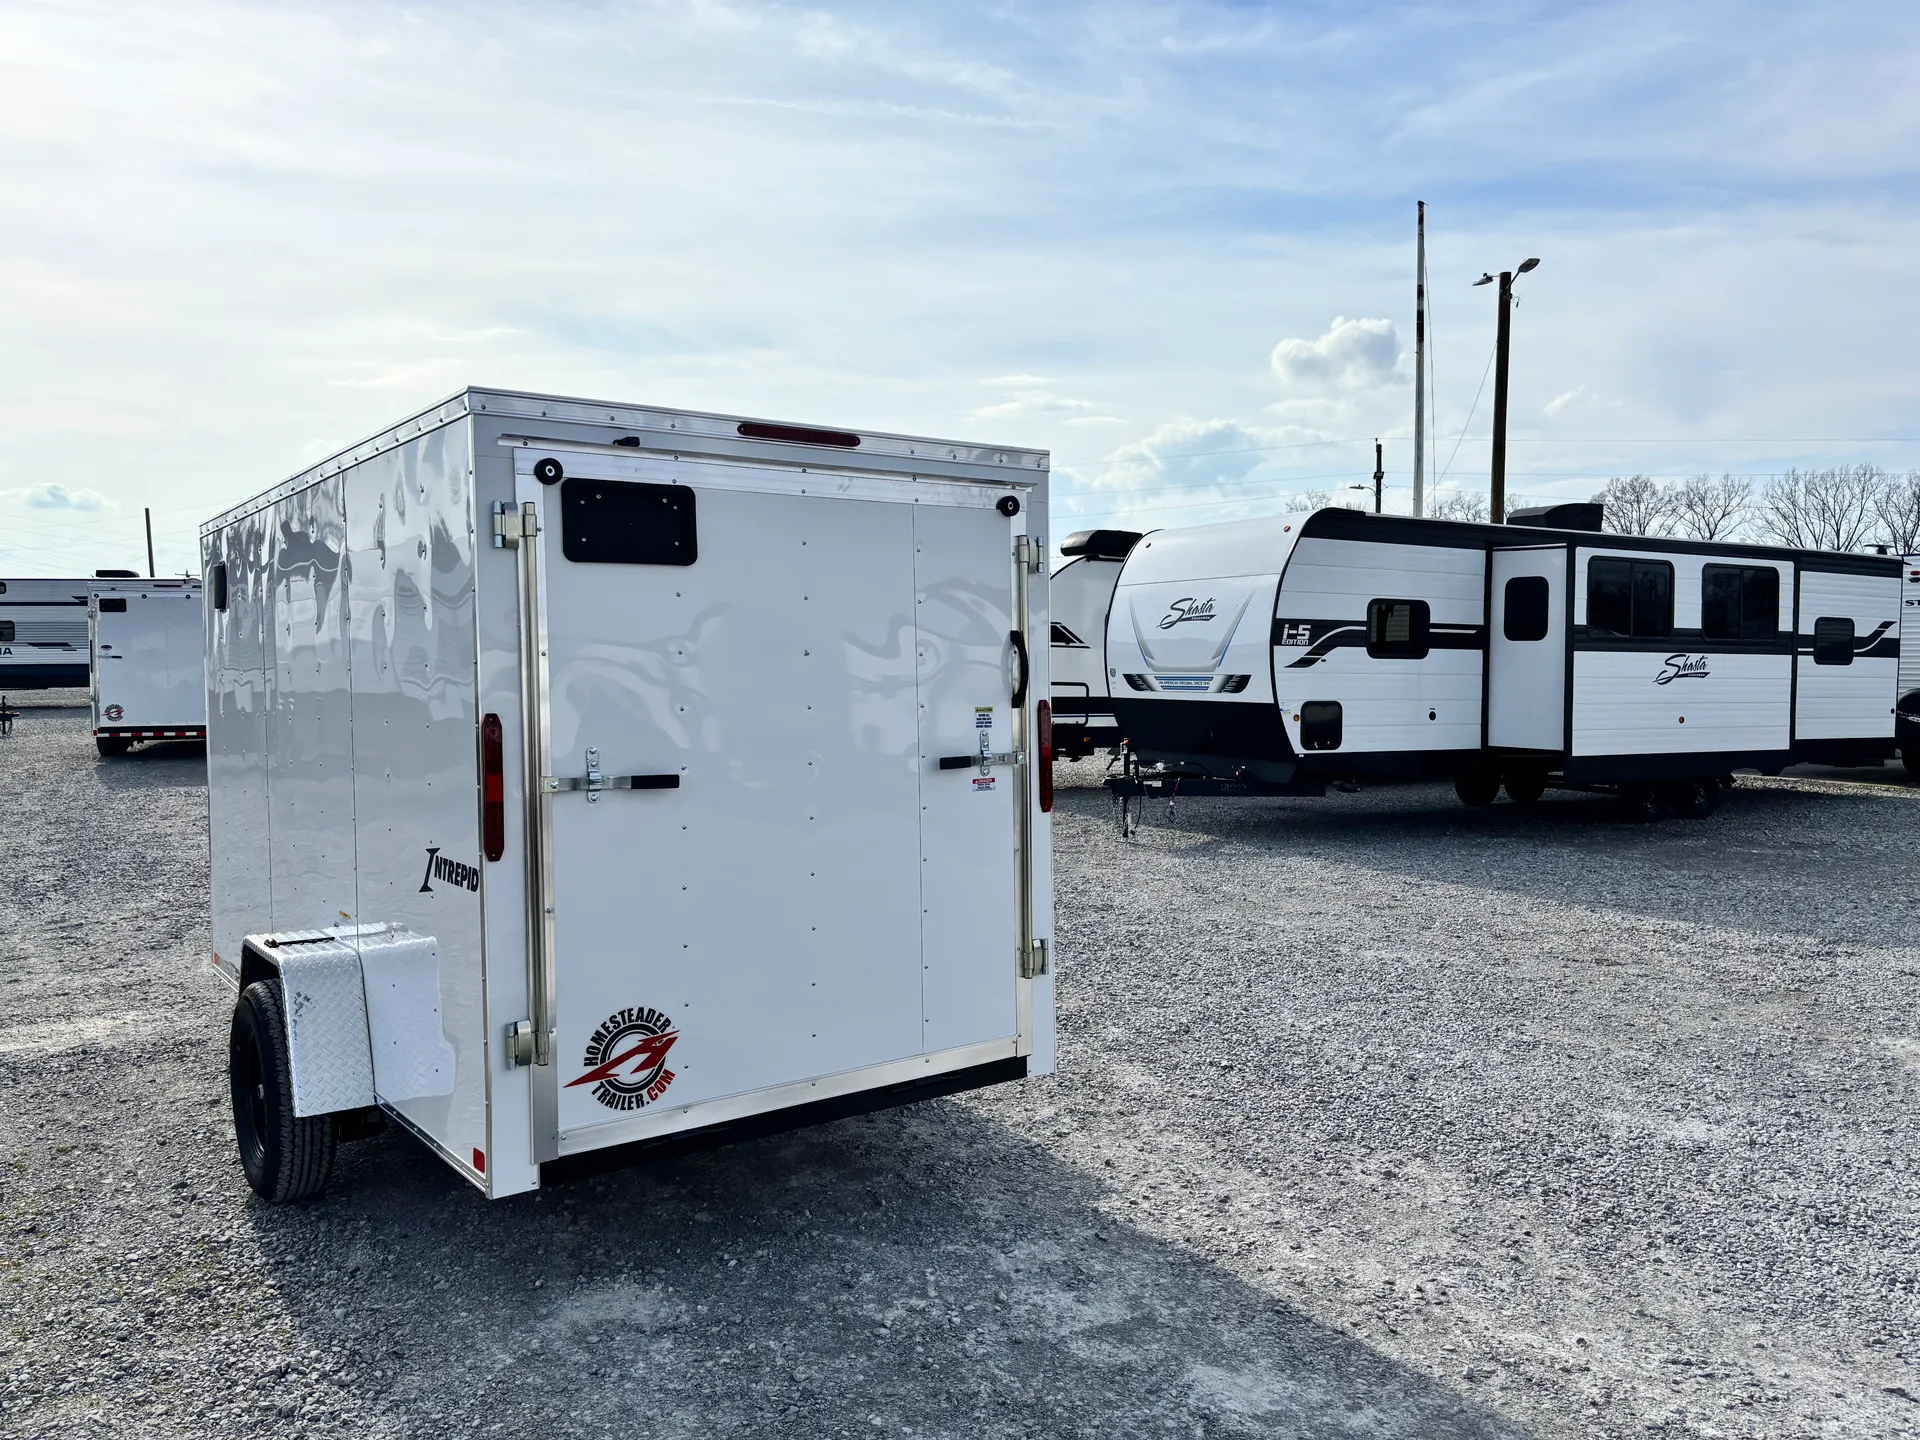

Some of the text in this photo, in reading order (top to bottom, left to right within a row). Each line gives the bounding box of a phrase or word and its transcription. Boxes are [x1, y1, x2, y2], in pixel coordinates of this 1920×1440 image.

[1156, 597, 1216, 630] Shasta
[1282, 623, 1312, 640] i-5
[1652, 653, 1709, 686] Shasta
[419, 847, 480, 893] INTREPID
[583, 1006, 672, 1067] HOMESTEADER
